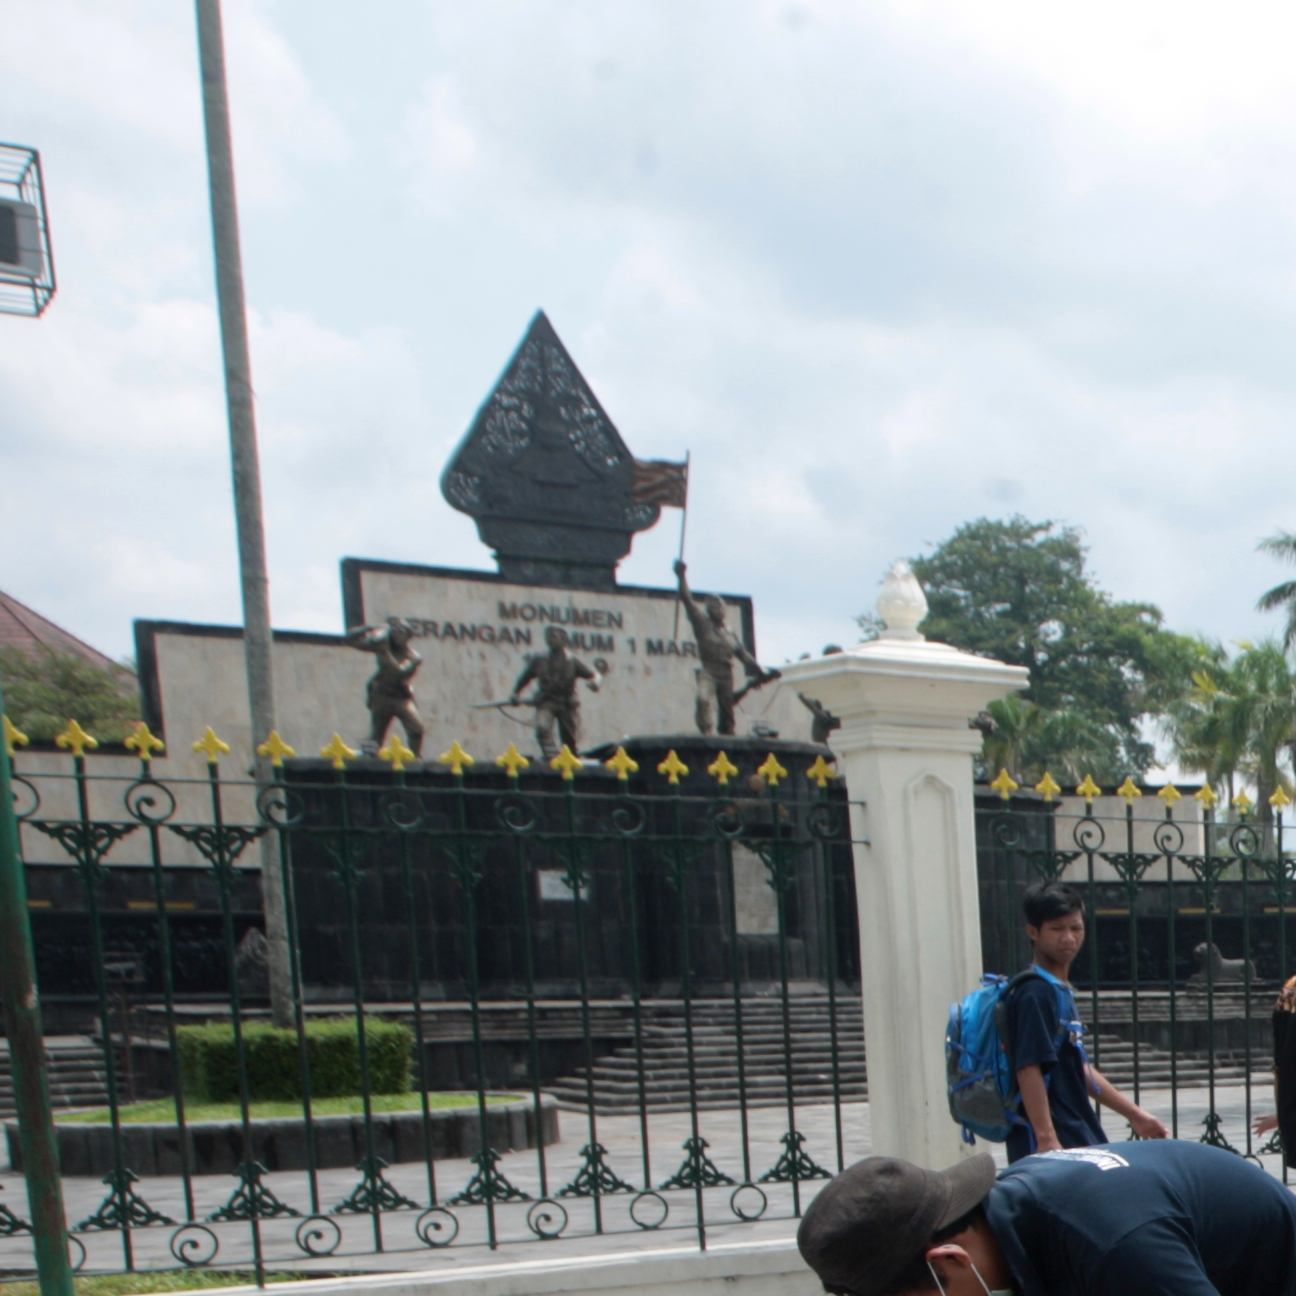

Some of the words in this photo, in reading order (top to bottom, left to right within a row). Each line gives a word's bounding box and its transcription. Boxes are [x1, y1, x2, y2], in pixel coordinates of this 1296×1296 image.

[497, 600, 623, 629] MONUMEN
[626, 637, 637, 654] 1
[645, 637, 698, 657] MAR
